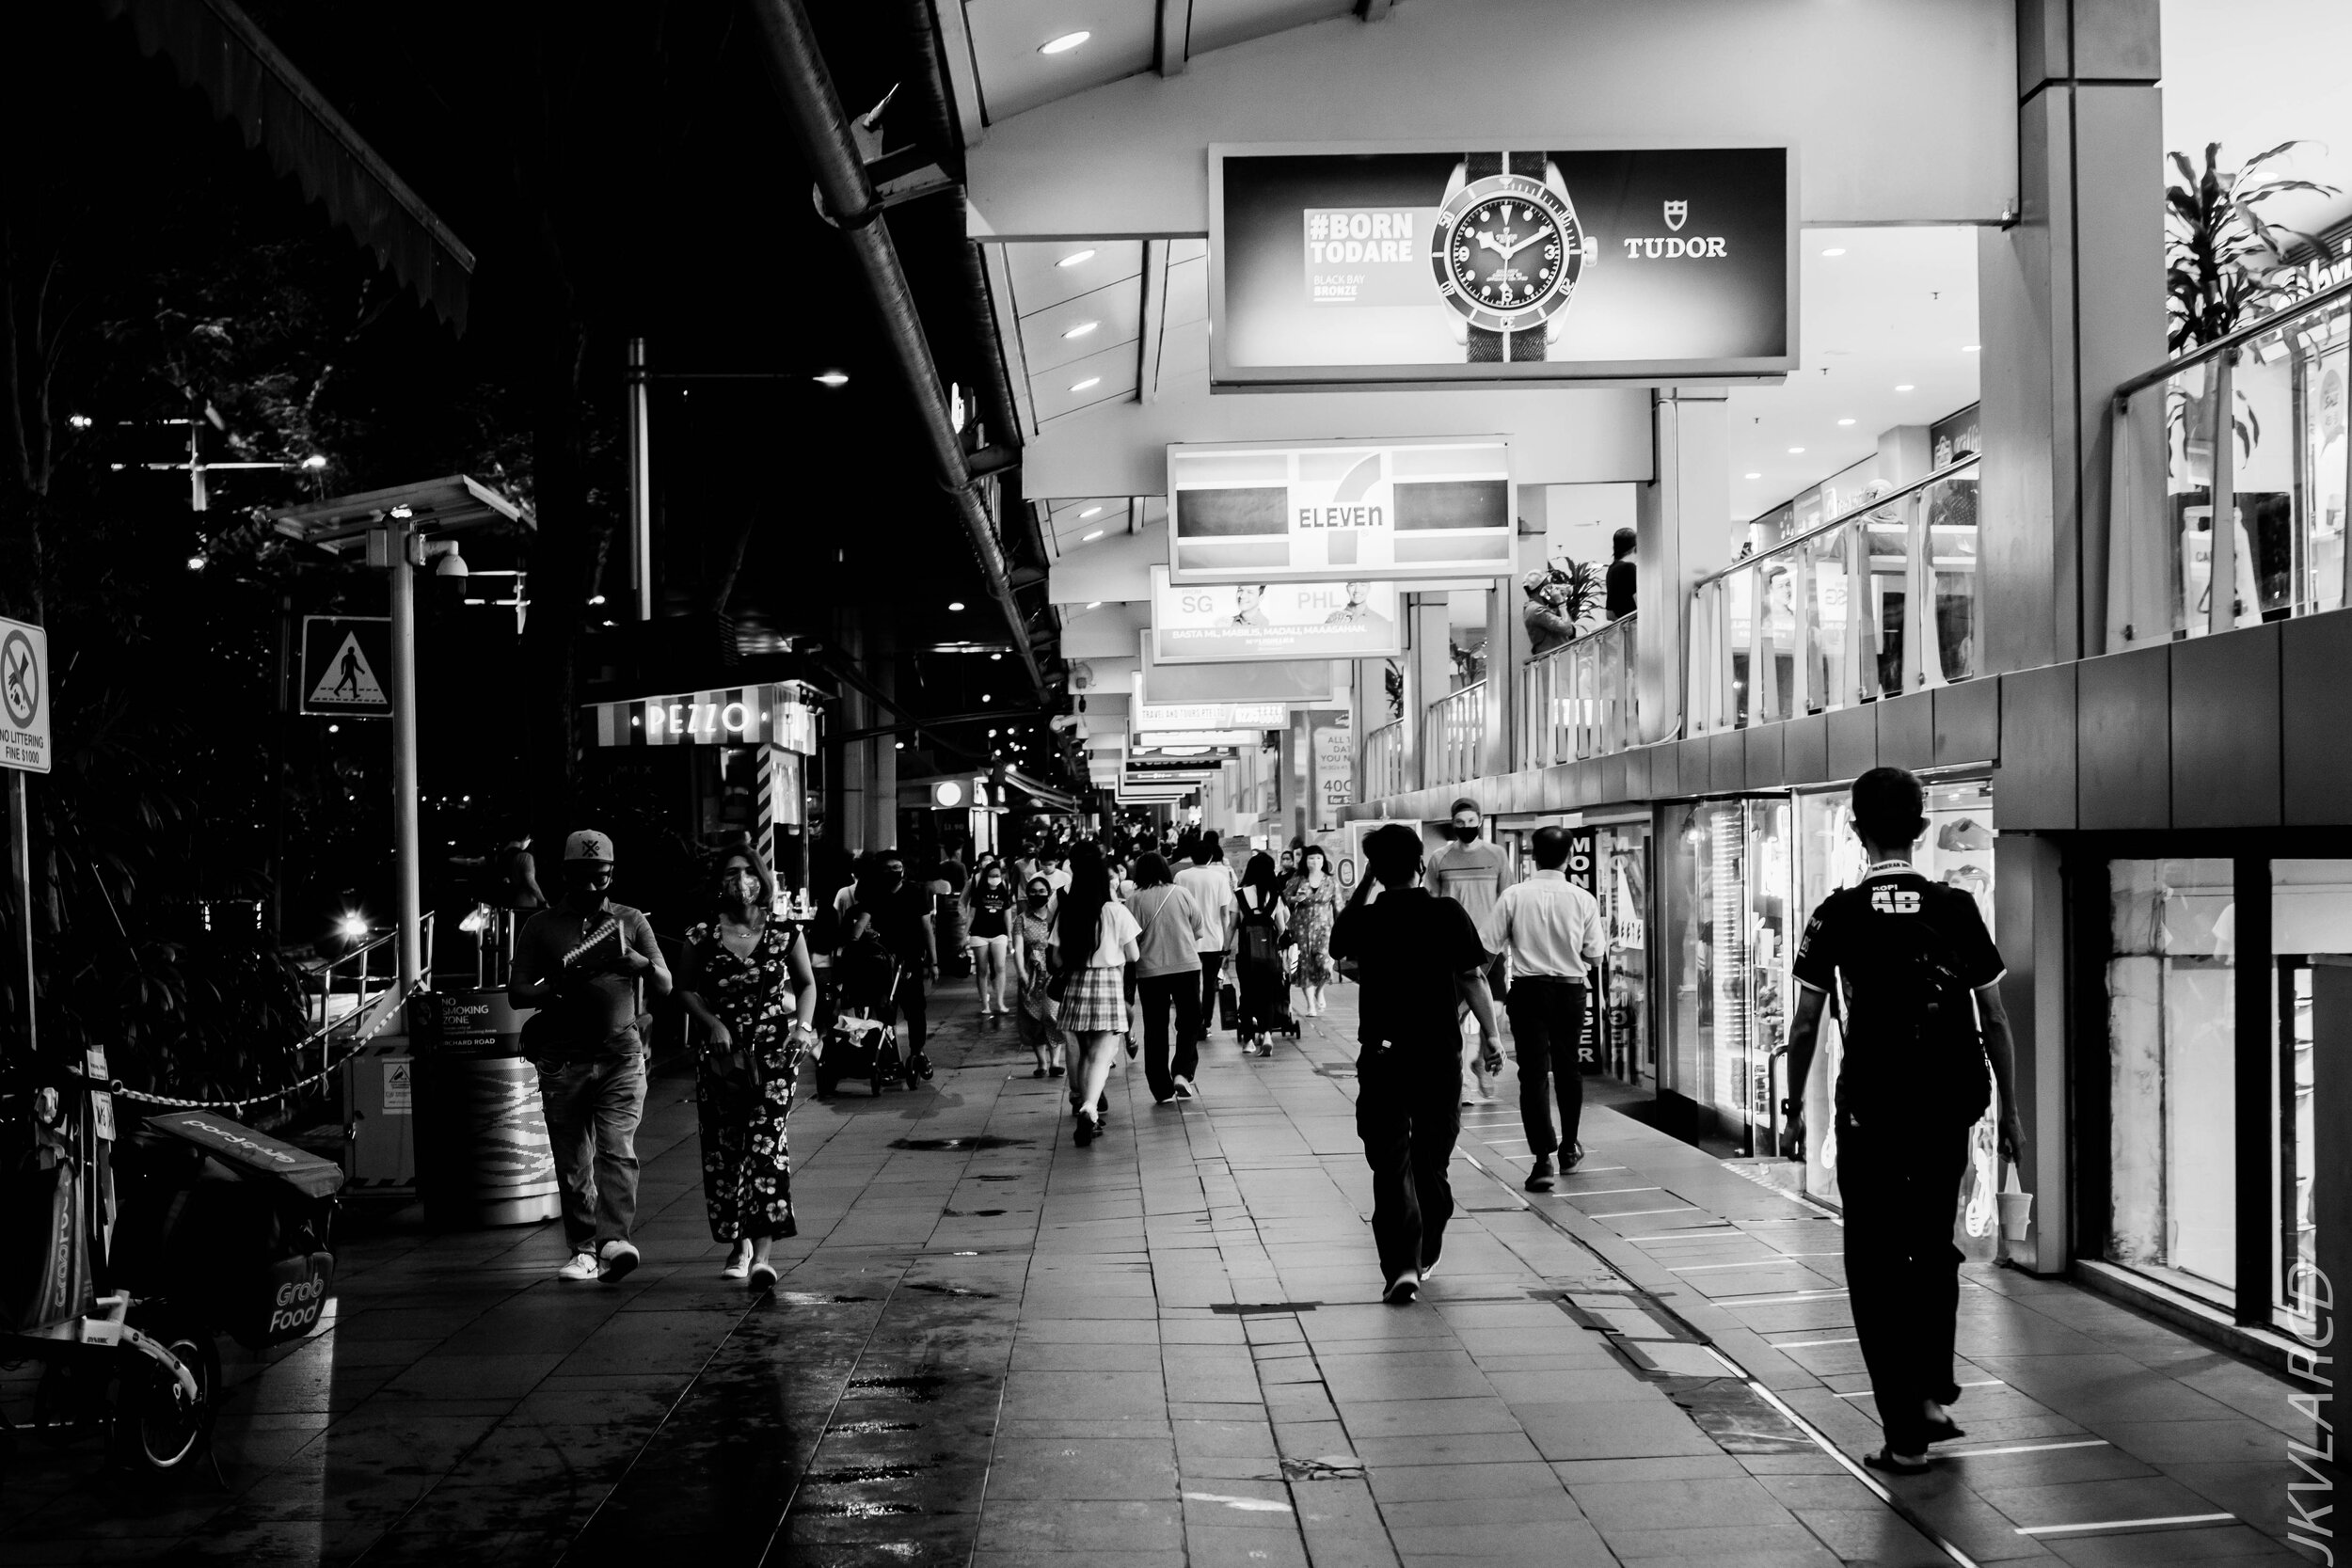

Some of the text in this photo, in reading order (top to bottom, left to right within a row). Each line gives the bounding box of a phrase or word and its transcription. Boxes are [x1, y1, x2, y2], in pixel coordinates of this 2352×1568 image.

[1311, 214, 1413, 240] #BORN
[1311, 241, 1413, 263] TODARE
[1544, 245, 1556, 260] 3
[1625, 236, 1727, 259] TUDOR
[1314, 275, 1365, 285] BLACK BAY
[1314, 286, 1358, 296] BRONZE
[1182, 595, 1214, 613] SG
[1297, 591, 1343, 610] PHL
[1172, 630, 1202, 639] BASTA
[649, 703, 750, 735] PEZZO
[0, 728, 43, 749] NO LITTERING
[6, 746, 39, 764] FINE $1000
[1871, 891, 1920, 913] AB
[441, 997, 456, 1006] NO
[442, 1005, 488, 1015] SMOKING
[443, 1015, 469, 1024] ZONE
[277, 1273, 324, 1307] Grab
[269, 1298, 320, 1333] Food
